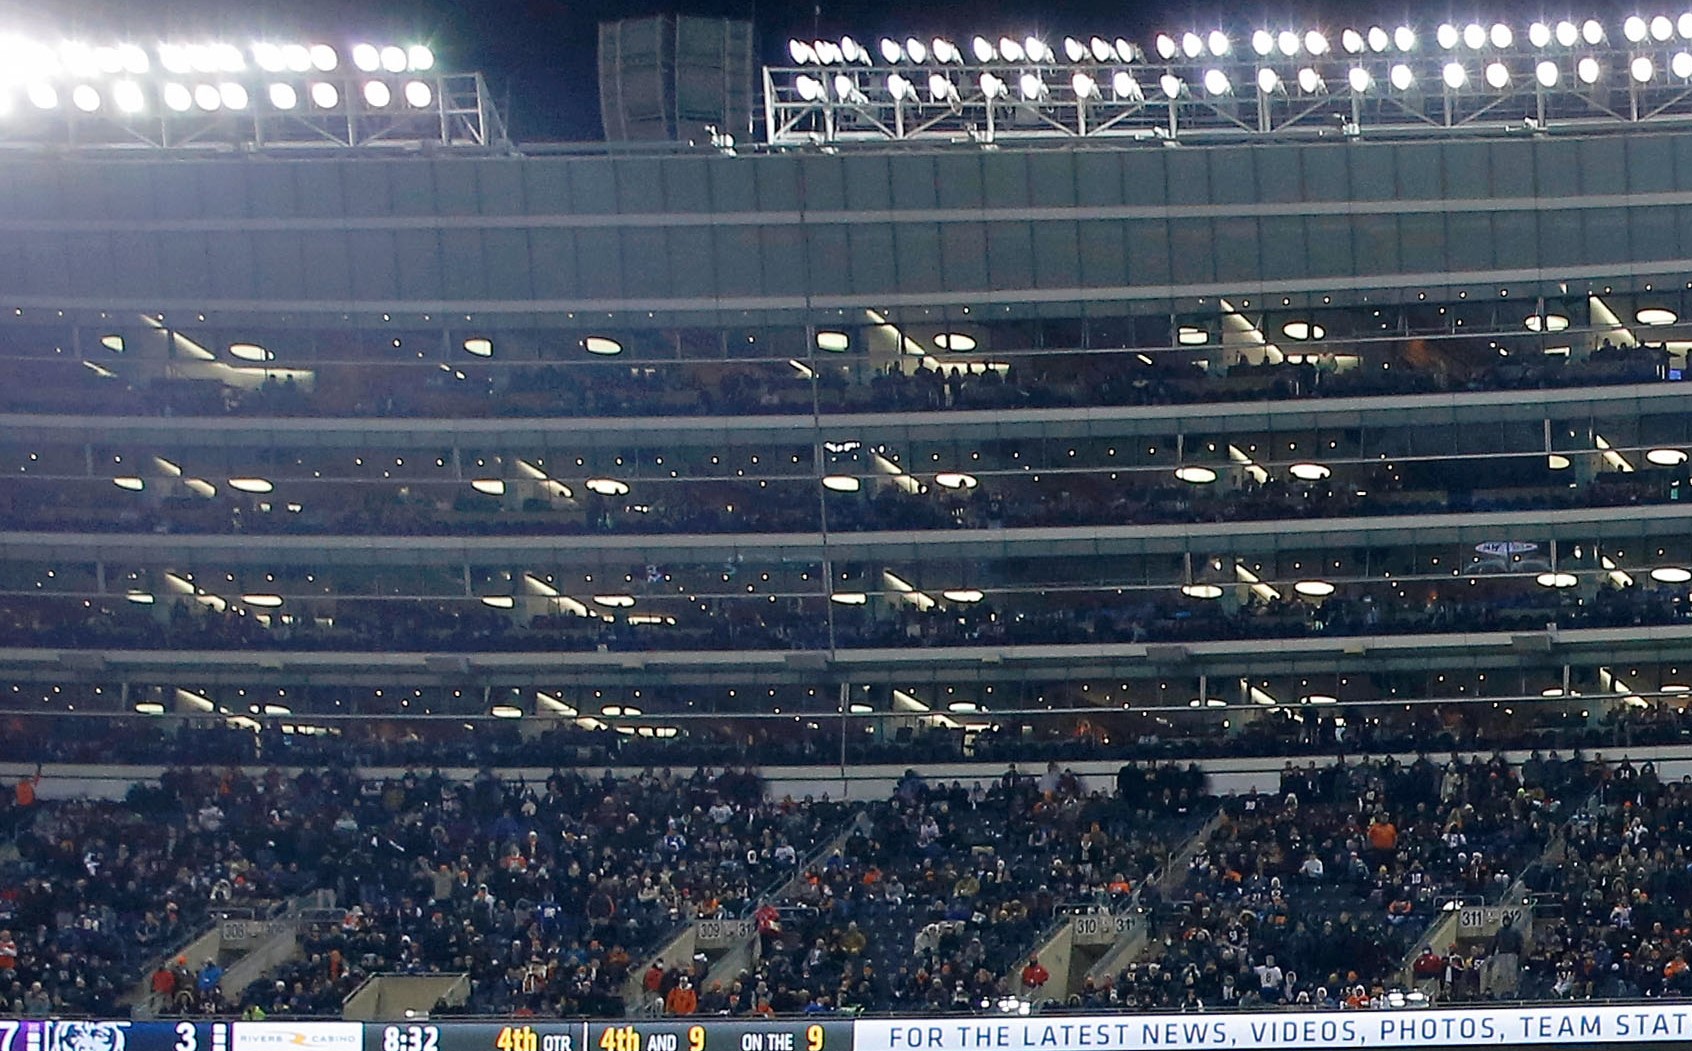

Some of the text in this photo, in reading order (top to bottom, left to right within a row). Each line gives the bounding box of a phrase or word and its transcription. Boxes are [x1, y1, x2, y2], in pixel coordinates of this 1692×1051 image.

[1077, 918, 1096, 934] 310
[1461, 911, 1482, 926] 311
[700, 923, 720, 938] 309
[739, 923, 754, 938] 31
[240, 1034, 356, 1043] RIVERS CASINO
[889, 1026, 943, 1049] FOR
[957, 1026, 1010, 1048] THE
[1022, 1024, 1129, 1047] LATEST
[1142, 1022, 1238, 1048] NEWS,
[1251, 1020, 1368, 1045] VIDEOS,
[1380, 1017, 1505, 1042] PHOTOS,
[1520, 1015, 1601, 1038] TEAM
[768, 1033, 793, 1051] THE
